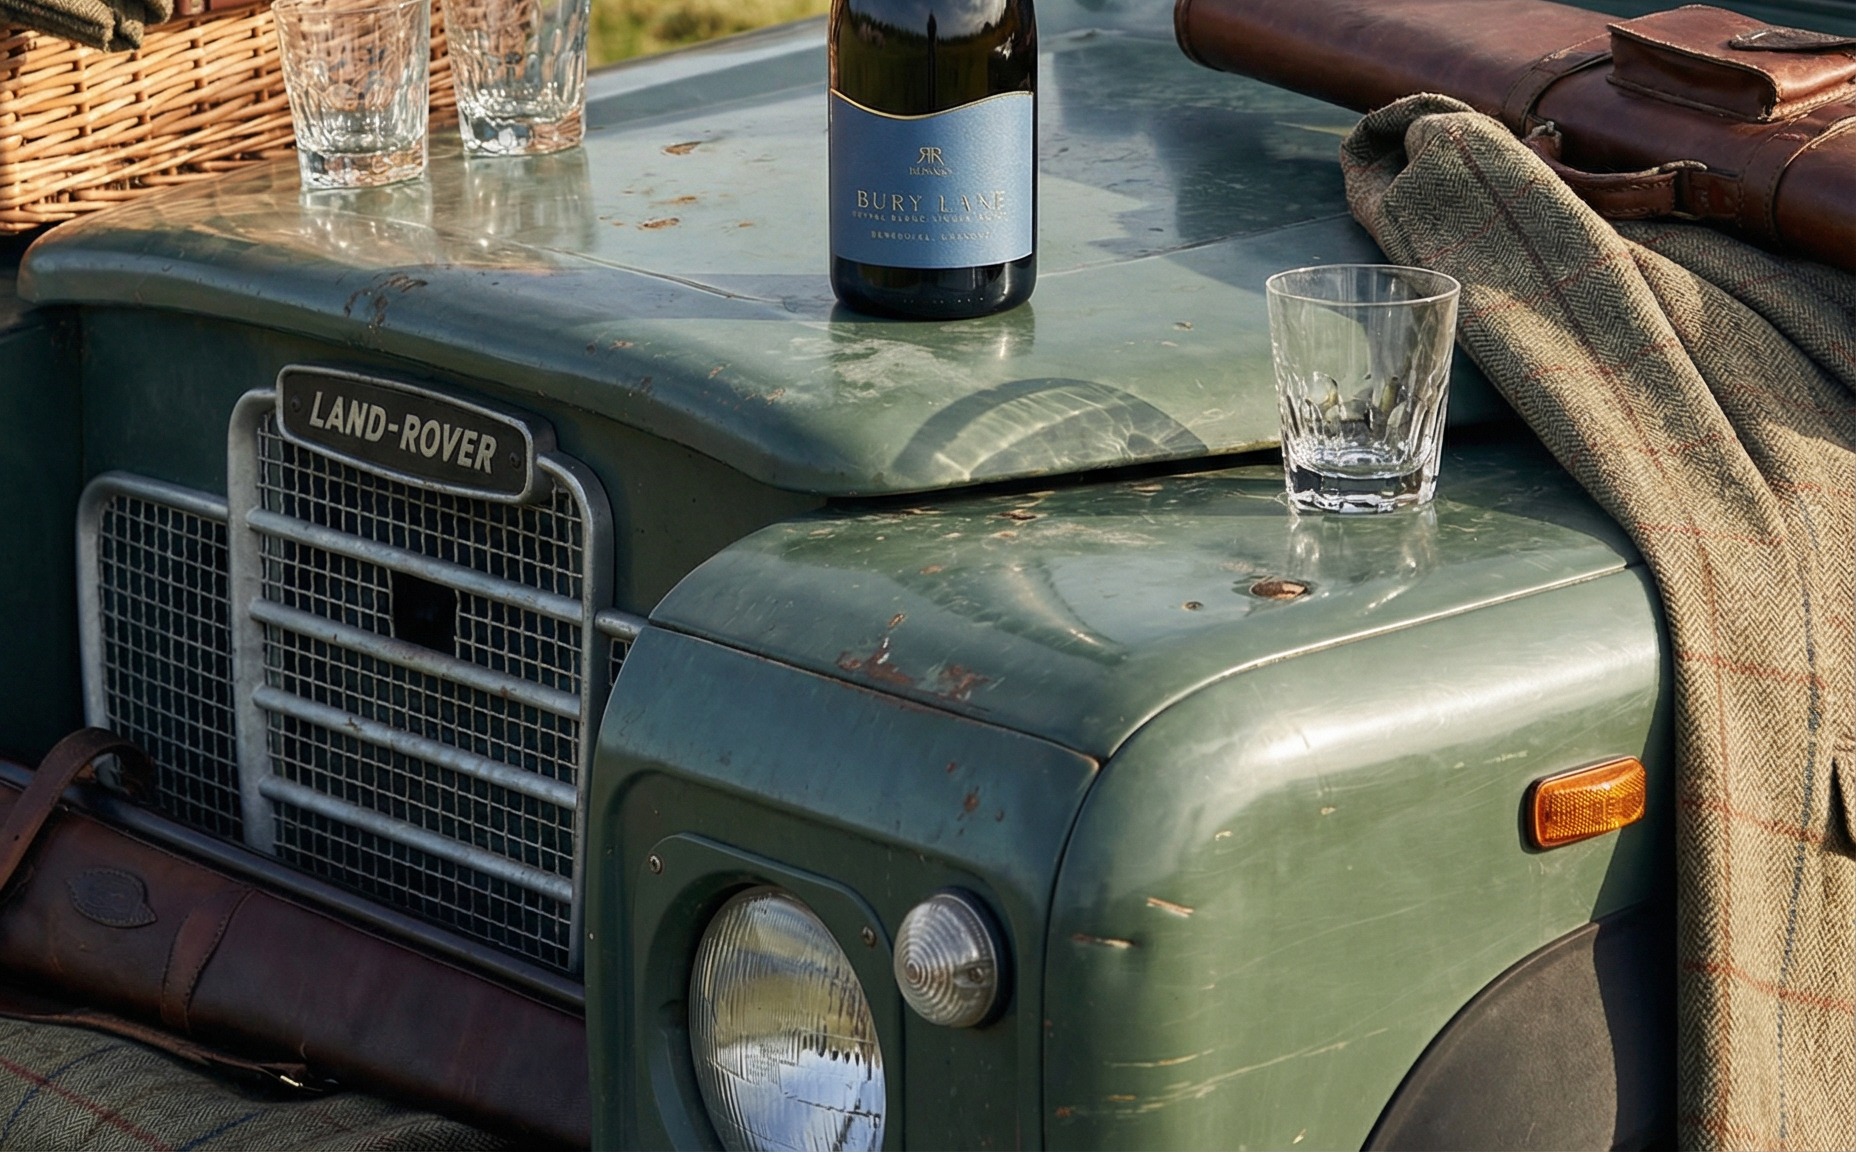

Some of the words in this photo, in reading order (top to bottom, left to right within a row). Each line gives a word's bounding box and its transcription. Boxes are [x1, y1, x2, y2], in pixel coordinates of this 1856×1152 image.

[857, 189, 923, 213] BURY
[938, 190, 1006, 213] LANE
[309, 391, 497, 475] LAND-ROVER
